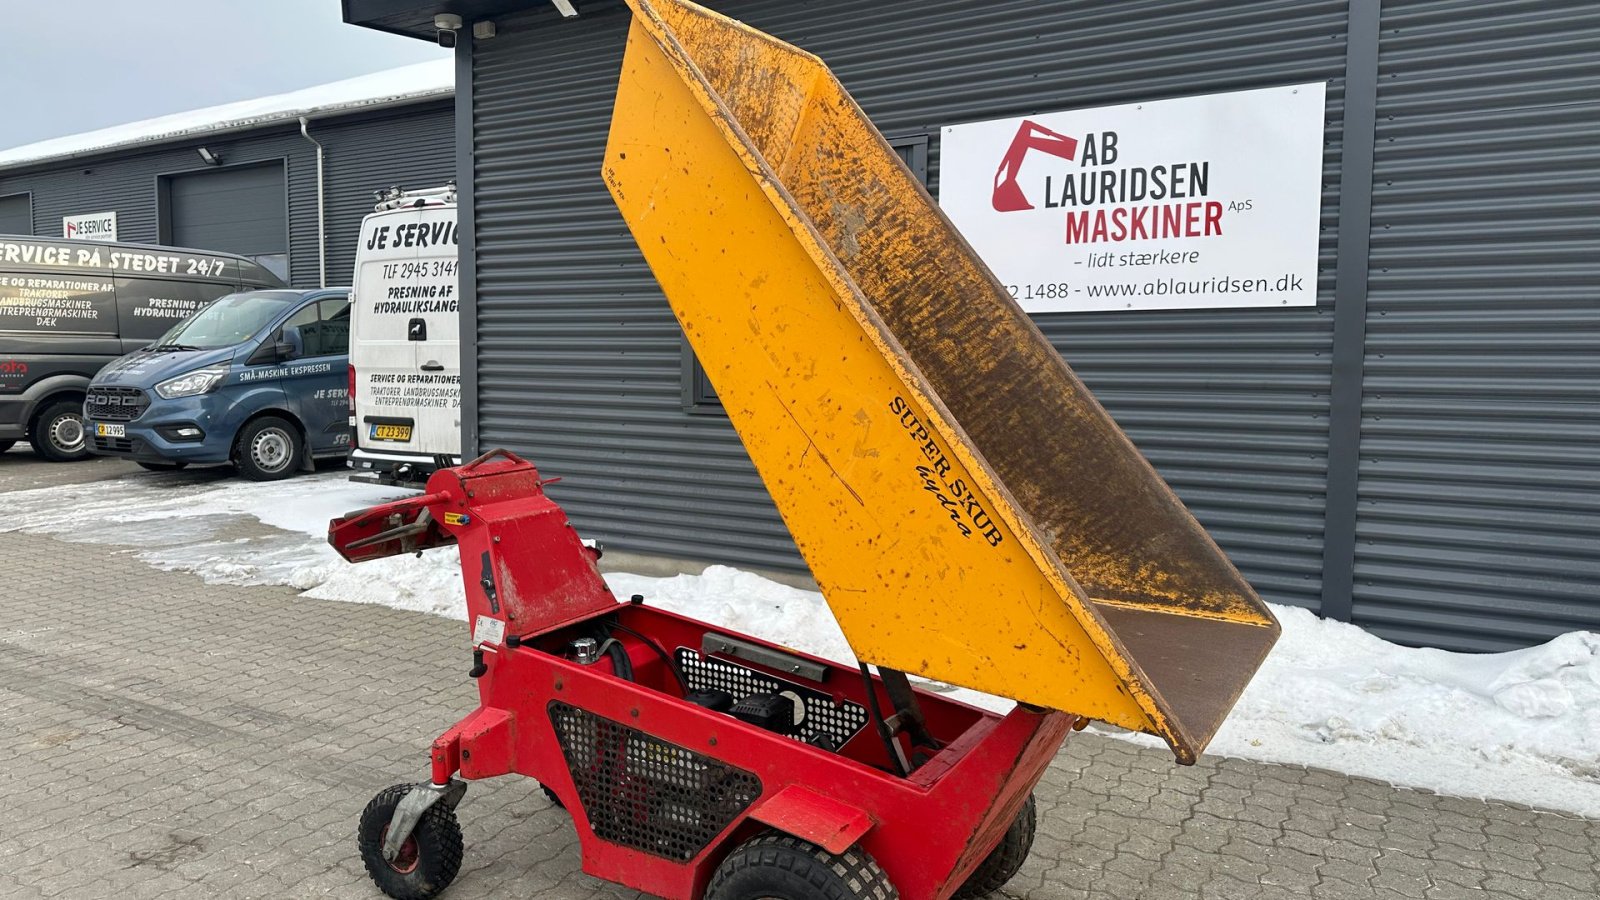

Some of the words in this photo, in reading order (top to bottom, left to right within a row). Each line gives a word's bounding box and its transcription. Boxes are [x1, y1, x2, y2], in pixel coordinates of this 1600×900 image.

[1081, 131, 1118, 167] AB
[1045, 162, 1209, 209] LAURIDSEN
[76, 221, 83, 234] JE
[84, 219, 112, 233] SERVICE
[1066, 201, 1223, 244] MASKINER
[1228, 200, 1253, 213] ApS
[367, 226, 390, 250] JE
[77, 248, 101, 268] PÅ
[109, 253, 180, 273] STEDET
[186, 258, 225, 277] 24/7
[1088, 252, 1115, 268] lidt
[1119, 249, 1200, 267] stærkere
[383, 264, 398, 279] TLF
[401, 262, 428, 279] 2945
[11, 278, 26, 287] OG
[28, 279, 99, 292] REPARATIONER
[388, 285, 437, 299] PRESNING
[439, 285, 453, 298] AF
[1003, 285, 1019, 300] 2
[1024, 283, 1069, 299] 1488
[1087, 274, 1304, 298] www.ablauridsen.dk
[19, 288, 69, 299] TRAKTORER
[0, 297, 92, 309] ANDBRUGSMASKINER
[149, 298, 196, 309] PRESNING
[374, 300, 460, 314] HYDRAULIKSLANG
[133, 307, 194, 318] HYDRAULIKS
[36, 317, 57, 326] DÆK
[240, 367, 289, 381] SMÅ-MASKINE
[291, 363, 331, 376] EKSPRESSEN
[370, 374, 396, 383] SERVICE
[397, 374, 406, 383] OG
[407, 375, 460, 384] REPARATIONER
[314, 390, 325, 399] JE
[327, 388, 349, 399] SERV
[370, 387, 401, 396] TRAKTORER
[375, 396, 448, 408] ENTREPRENØRMASKINER
[376, 427, 385, 437] CT
[386, 428, 395, 437] 23
[396, 428, 409, 438] 399
[889, 396, 951, 478] SUPER
[949, 479, 1003, 547] SKUB
[916, 465, 972, 539] hydra
